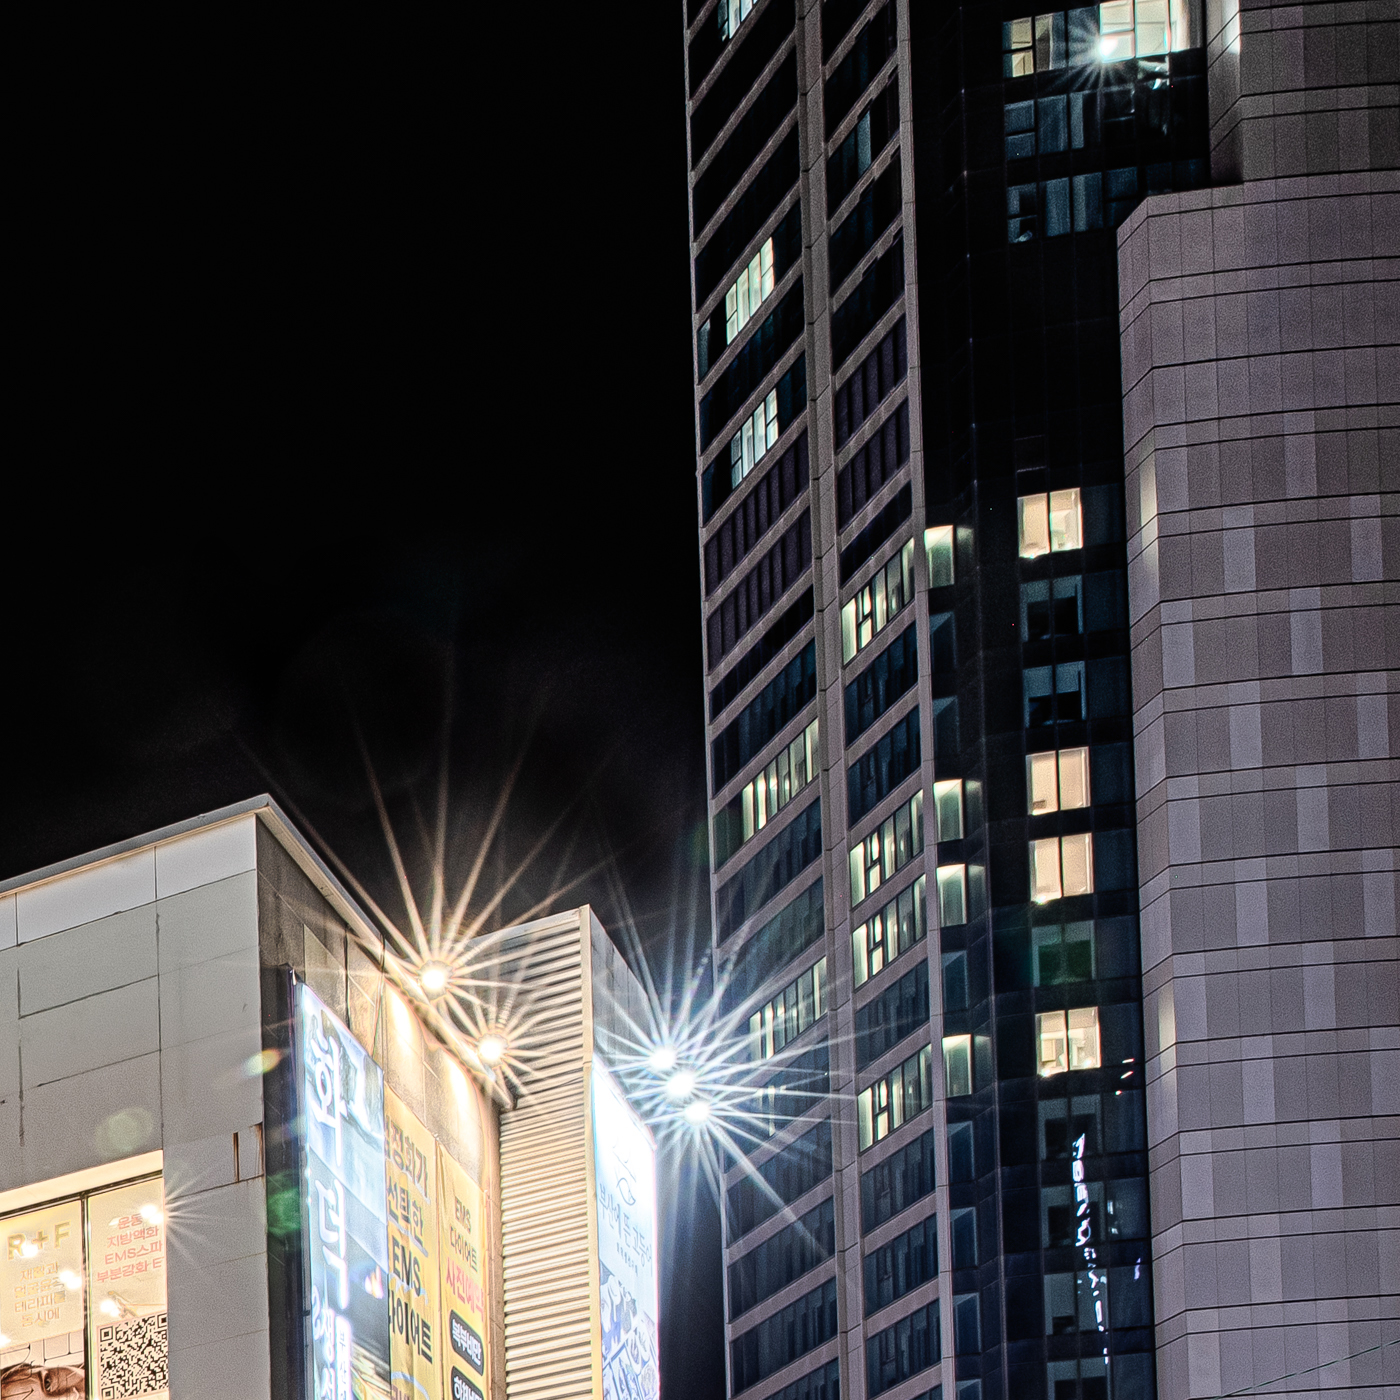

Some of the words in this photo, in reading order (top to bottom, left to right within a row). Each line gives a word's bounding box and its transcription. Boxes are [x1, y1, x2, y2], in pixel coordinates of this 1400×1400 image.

[386, 1115, 428, 1198] 정화가
[107, 1227, 159, 1247] 지방액화
[455, 1196, 471, 1234] EMS
[392, 1236, 421, 1297] EMS
[450, 1226, 478, 1272] 다이어트
[97, 1262, 148, 1283] 부분강화
[446, 1257, 484, 1322] 사전예약
